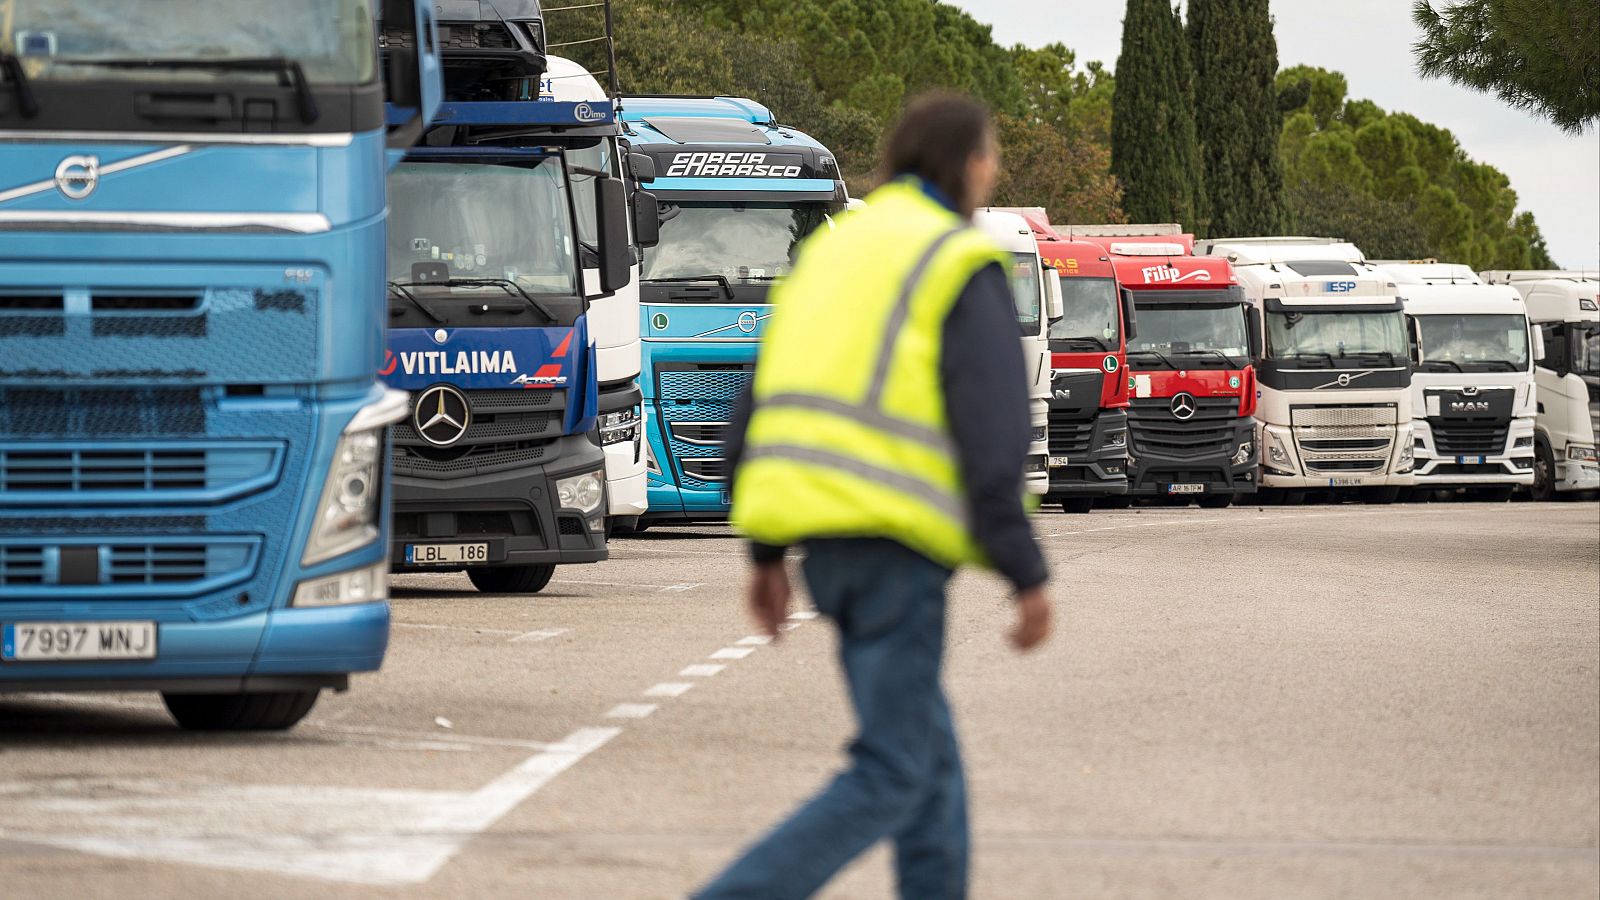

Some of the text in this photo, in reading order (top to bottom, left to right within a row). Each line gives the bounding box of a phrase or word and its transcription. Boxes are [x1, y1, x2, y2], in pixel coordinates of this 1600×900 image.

[672, 152, 767, 164] GARCIA
[666, 164, 802, 177] CARRASCO
[1141, 265, 1180, 284] Filip
[1330, 281, 1357, 292] ESP
[400, 351, 517, 374] VITLAIMA
[1451, 401, 1489, 411] MAN
[415, 545, 485, 561] LBL 186
[20, 628, 149, 654] 7997 MNJ
